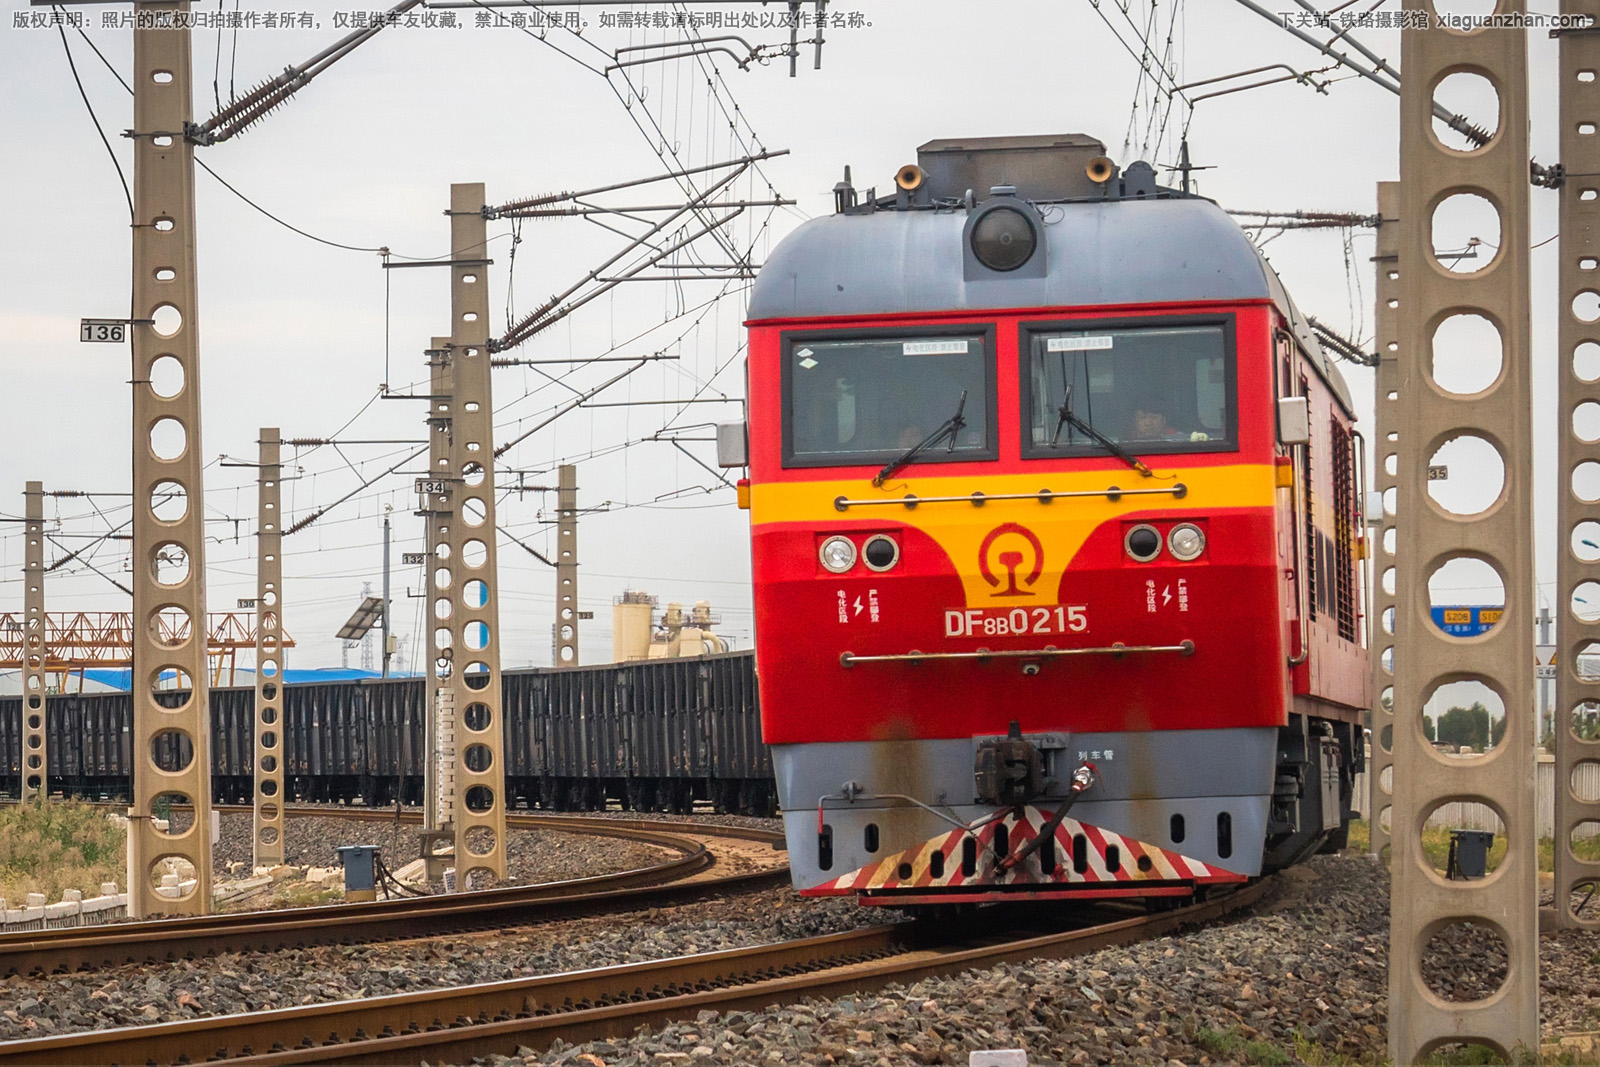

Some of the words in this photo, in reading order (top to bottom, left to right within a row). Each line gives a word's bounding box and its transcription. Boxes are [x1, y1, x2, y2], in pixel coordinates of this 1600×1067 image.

[84, 325, 122, 340] 136
[1429, 469, 1446, 480] 35
[417, 482, 442, 492] 134
[404, 555, 423, 564] 132
[1146, 579, 1157, 613] 电化区段
[837, 589, 849, 623] 电化区段
[1078, 749, 1114, 761] 列车管
